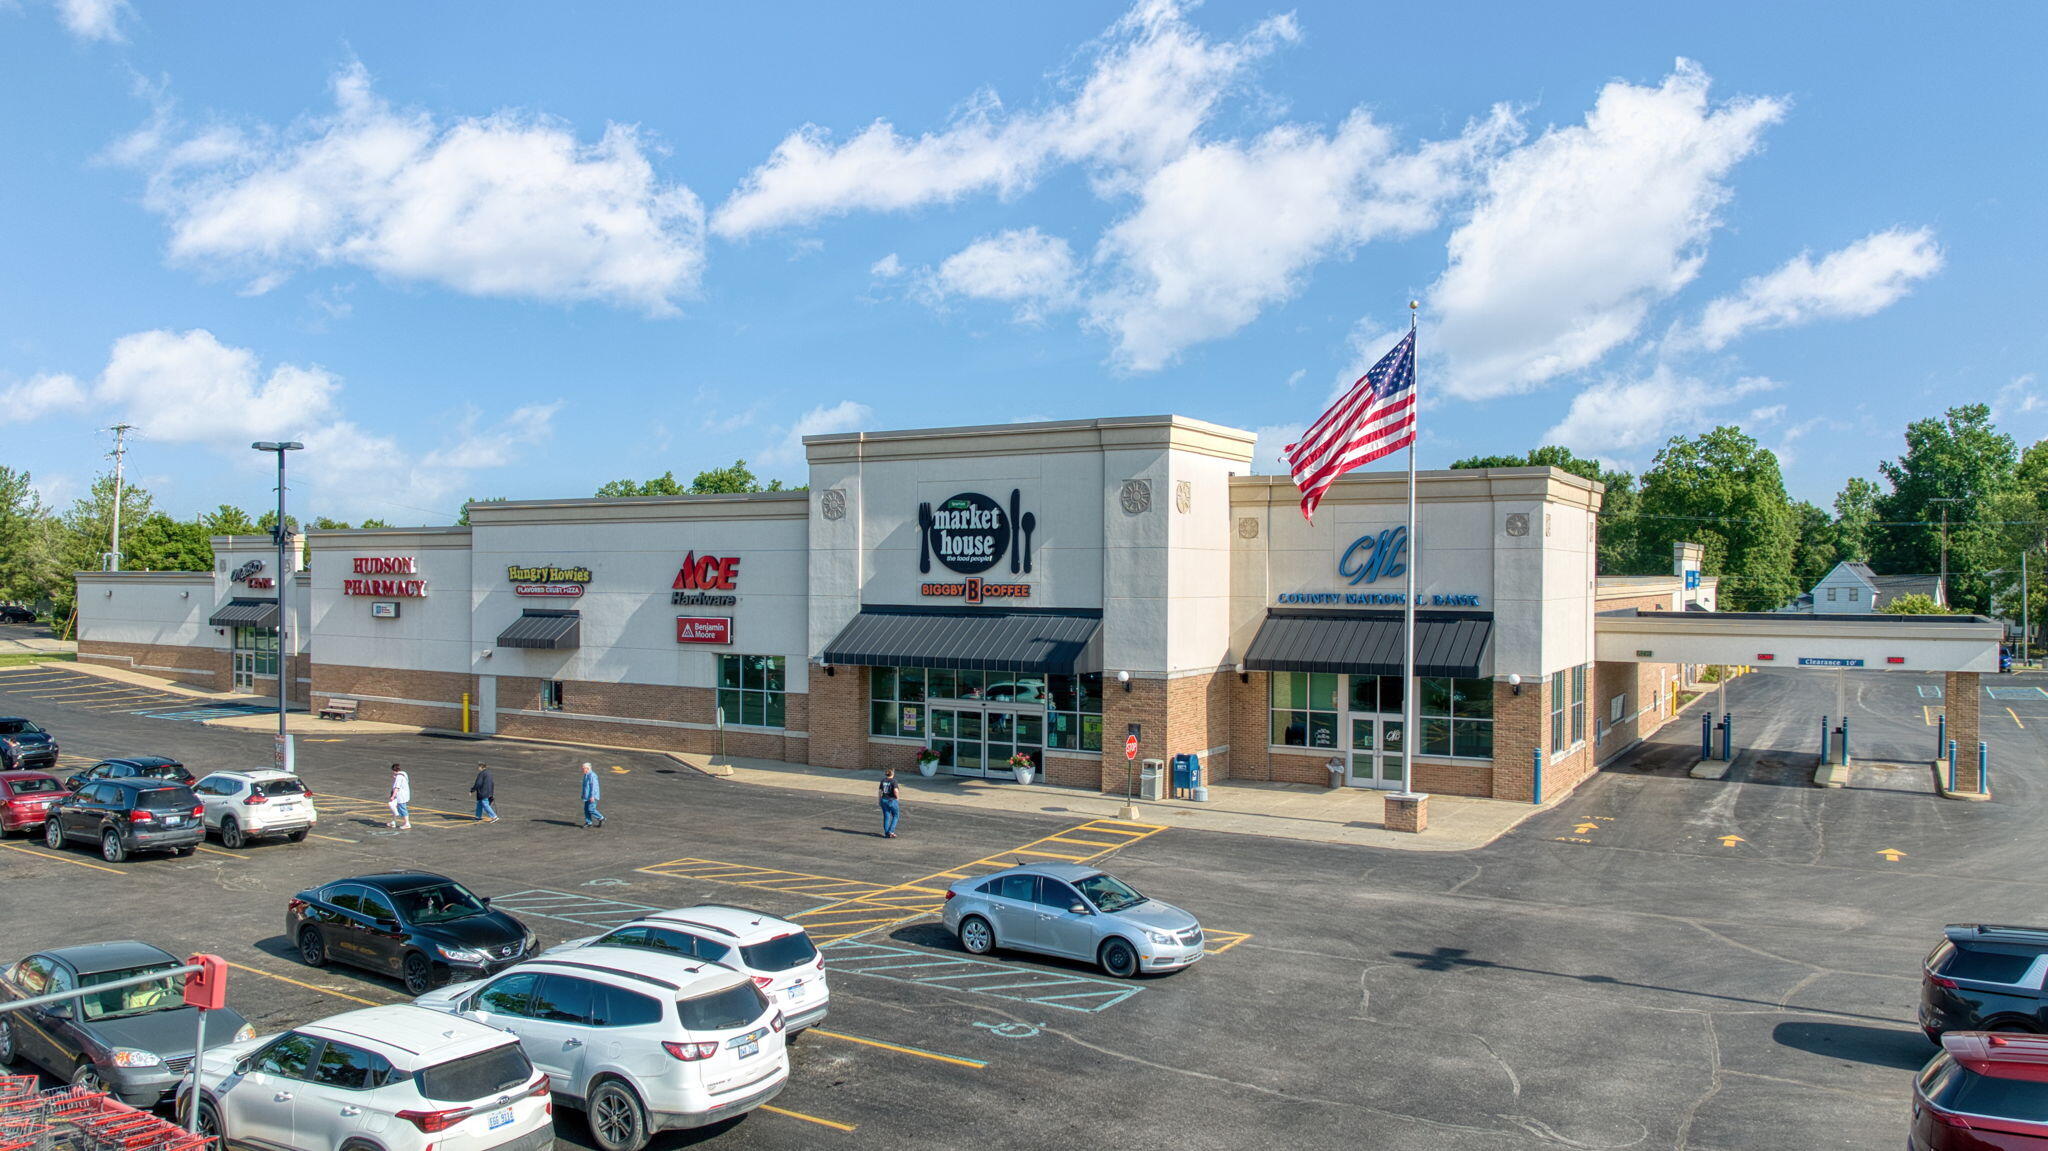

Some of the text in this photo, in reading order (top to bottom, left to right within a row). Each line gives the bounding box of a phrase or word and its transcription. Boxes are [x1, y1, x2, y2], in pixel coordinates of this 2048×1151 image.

[933, 504, 1000, 530] market
[940, 530, 994, 556] house
[353, 557, 415, 574] HUDSON
[970, 555, 992, 563] people!
[508, 566, 590, 582] Hungry Howie's
[672, 550, 740, 590] ACE
[344, 580, 426, 597] PHARMACY
[922, 580, 1031, 600] BIGGBY B COFFEE
[671, 592, 736, 606] Hardware
[1278, 593, 1480, 607] COUNTY NATIONL BANK
[694, 622, 724, 632] Benjamin
[1126, 742, 1138, 752] STOP
